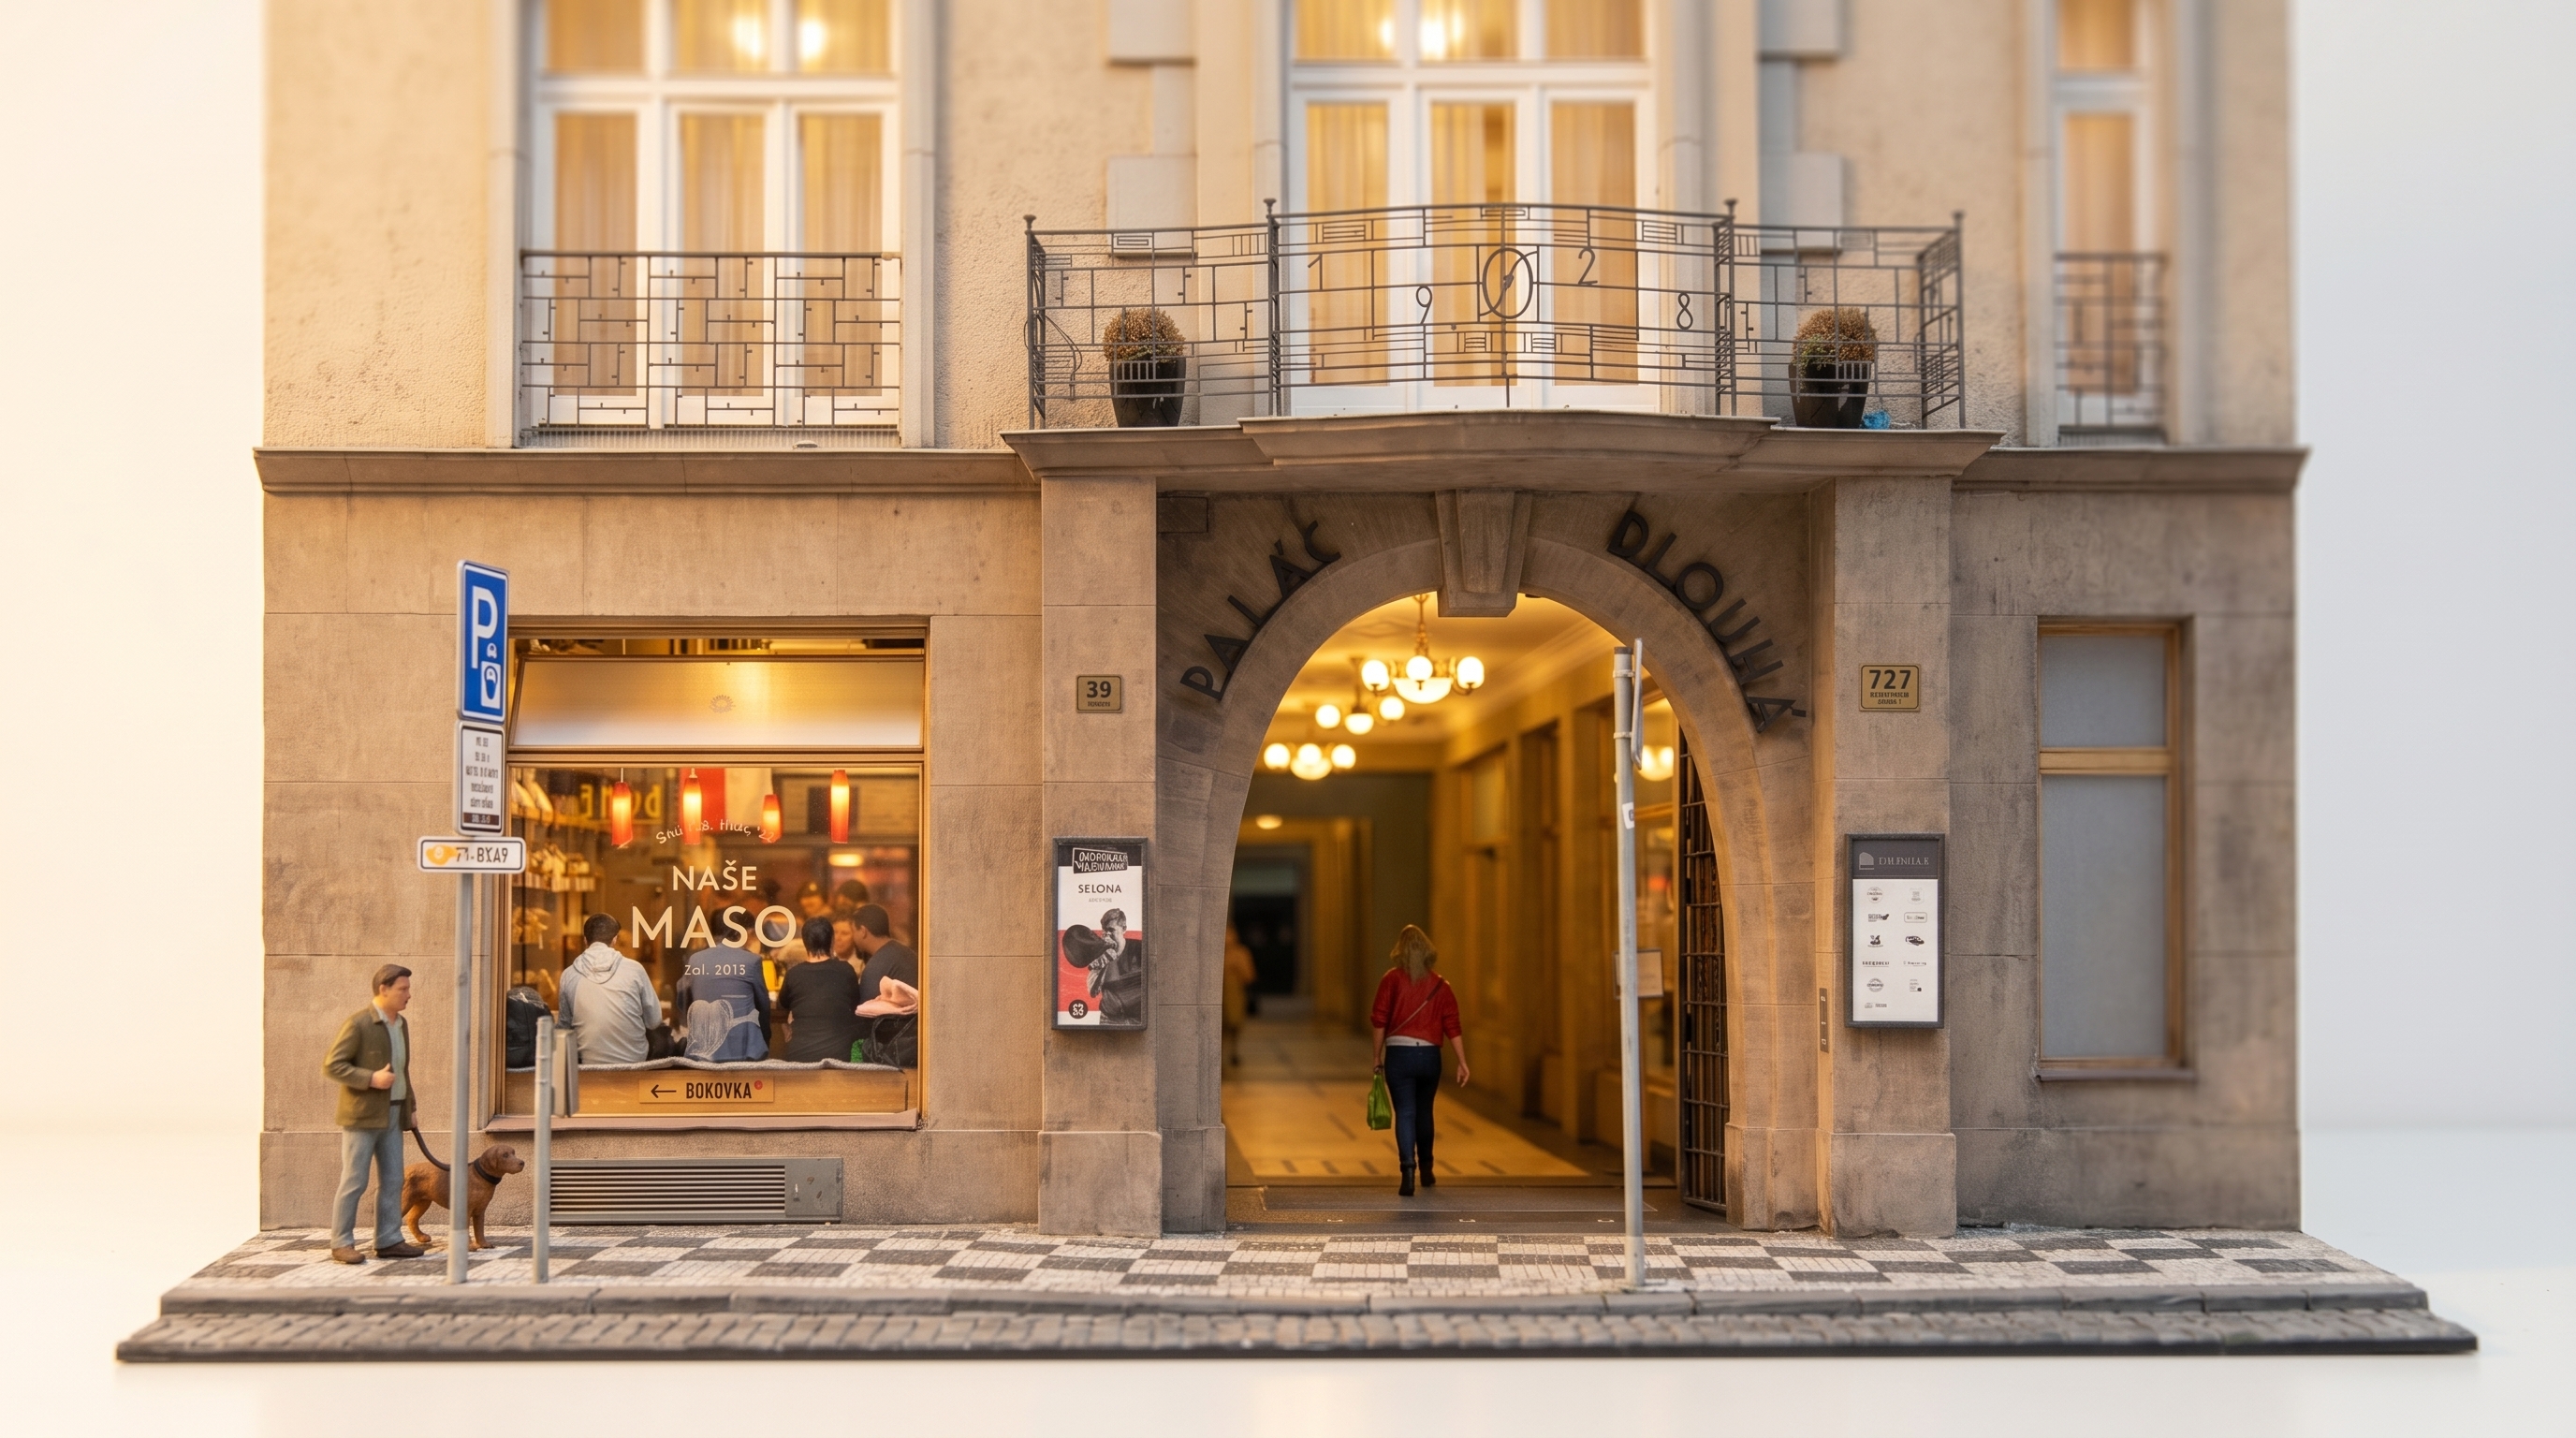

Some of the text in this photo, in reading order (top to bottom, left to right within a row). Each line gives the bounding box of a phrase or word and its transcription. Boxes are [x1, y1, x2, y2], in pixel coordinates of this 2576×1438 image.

[472, 585, 499, 669] P
[1869, 669, 1911, 689] 727
[1087, 681, 1111, 698] 39
[673, 859, 757, 891] NAŠE
[1078, 884, 1121, 893] SELONA
[632, 905, 797, 948] MASO
[684, 964, 710, 976] Zal.
[686, 1082, 752, 1099] BOKOVKA
